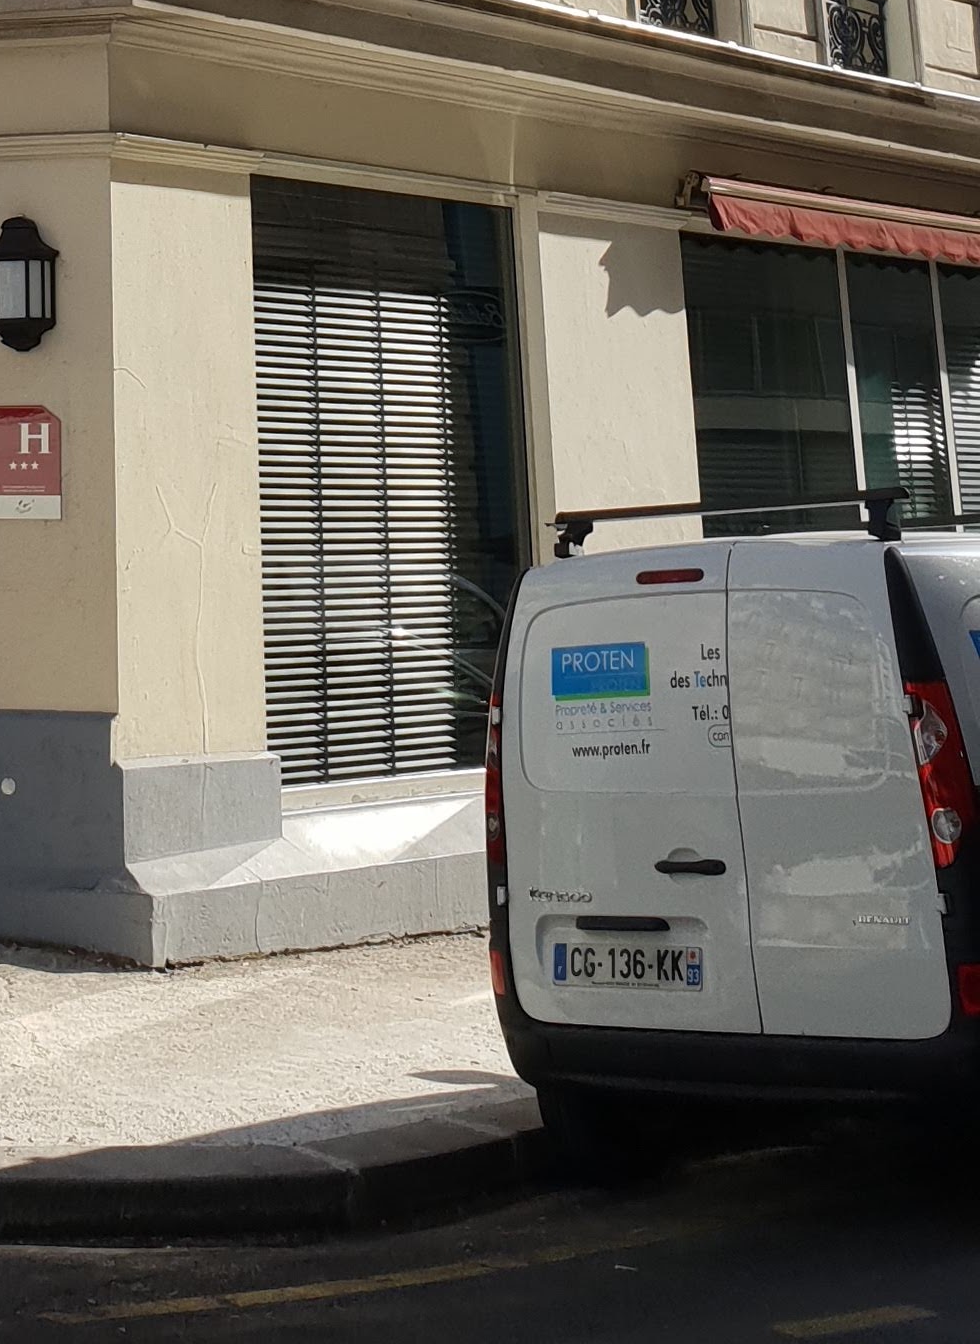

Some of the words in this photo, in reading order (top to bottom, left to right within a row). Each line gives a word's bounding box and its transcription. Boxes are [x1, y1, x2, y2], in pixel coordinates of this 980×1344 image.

[18, 422, 52, 455] H
[561, 649, 635, 673] PROTEN
[700, 643, 721, 661] Les
[670, 670, 691, 688] des
[600, 702, 607, 714] &
[610, 701, 652, 714] Services
[572, 738, 650, 760] www.proten.fr
[570, 946, 684, 982] CG-136-KK
